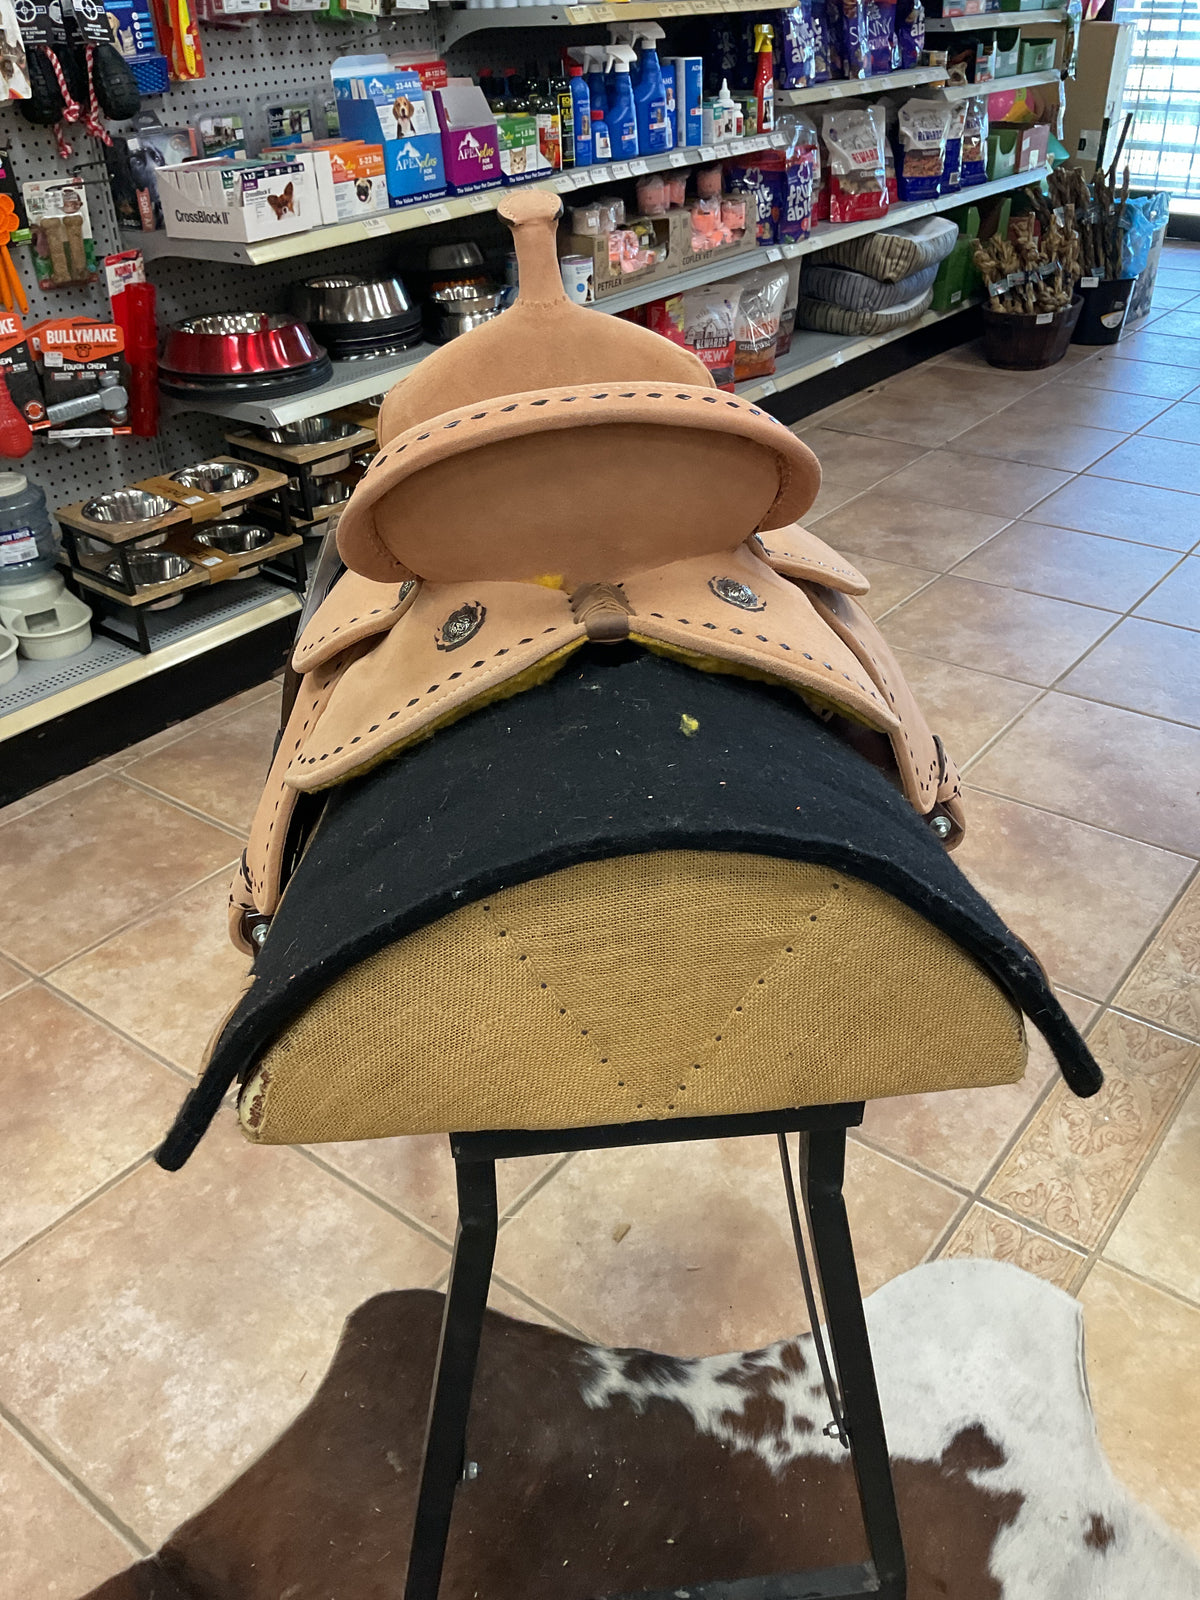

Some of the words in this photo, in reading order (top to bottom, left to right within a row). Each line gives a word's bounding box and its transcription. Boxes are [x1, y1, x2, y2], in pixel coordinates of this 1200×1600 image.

[478, 142, 494, 164] plus
[419, 153, 437, 174] plus
[395, 198, 403, 206] The
[175, 209, 222, 225] CrossBlock
[703, 250, 713, 260] VET
[597, 278, 622, 292] PETFLEX
[46, 328, 118, 345] BULLYMAKE
[63, 363, 85, 371] TOUGH
[86, 362, 107, 370] CHEW
